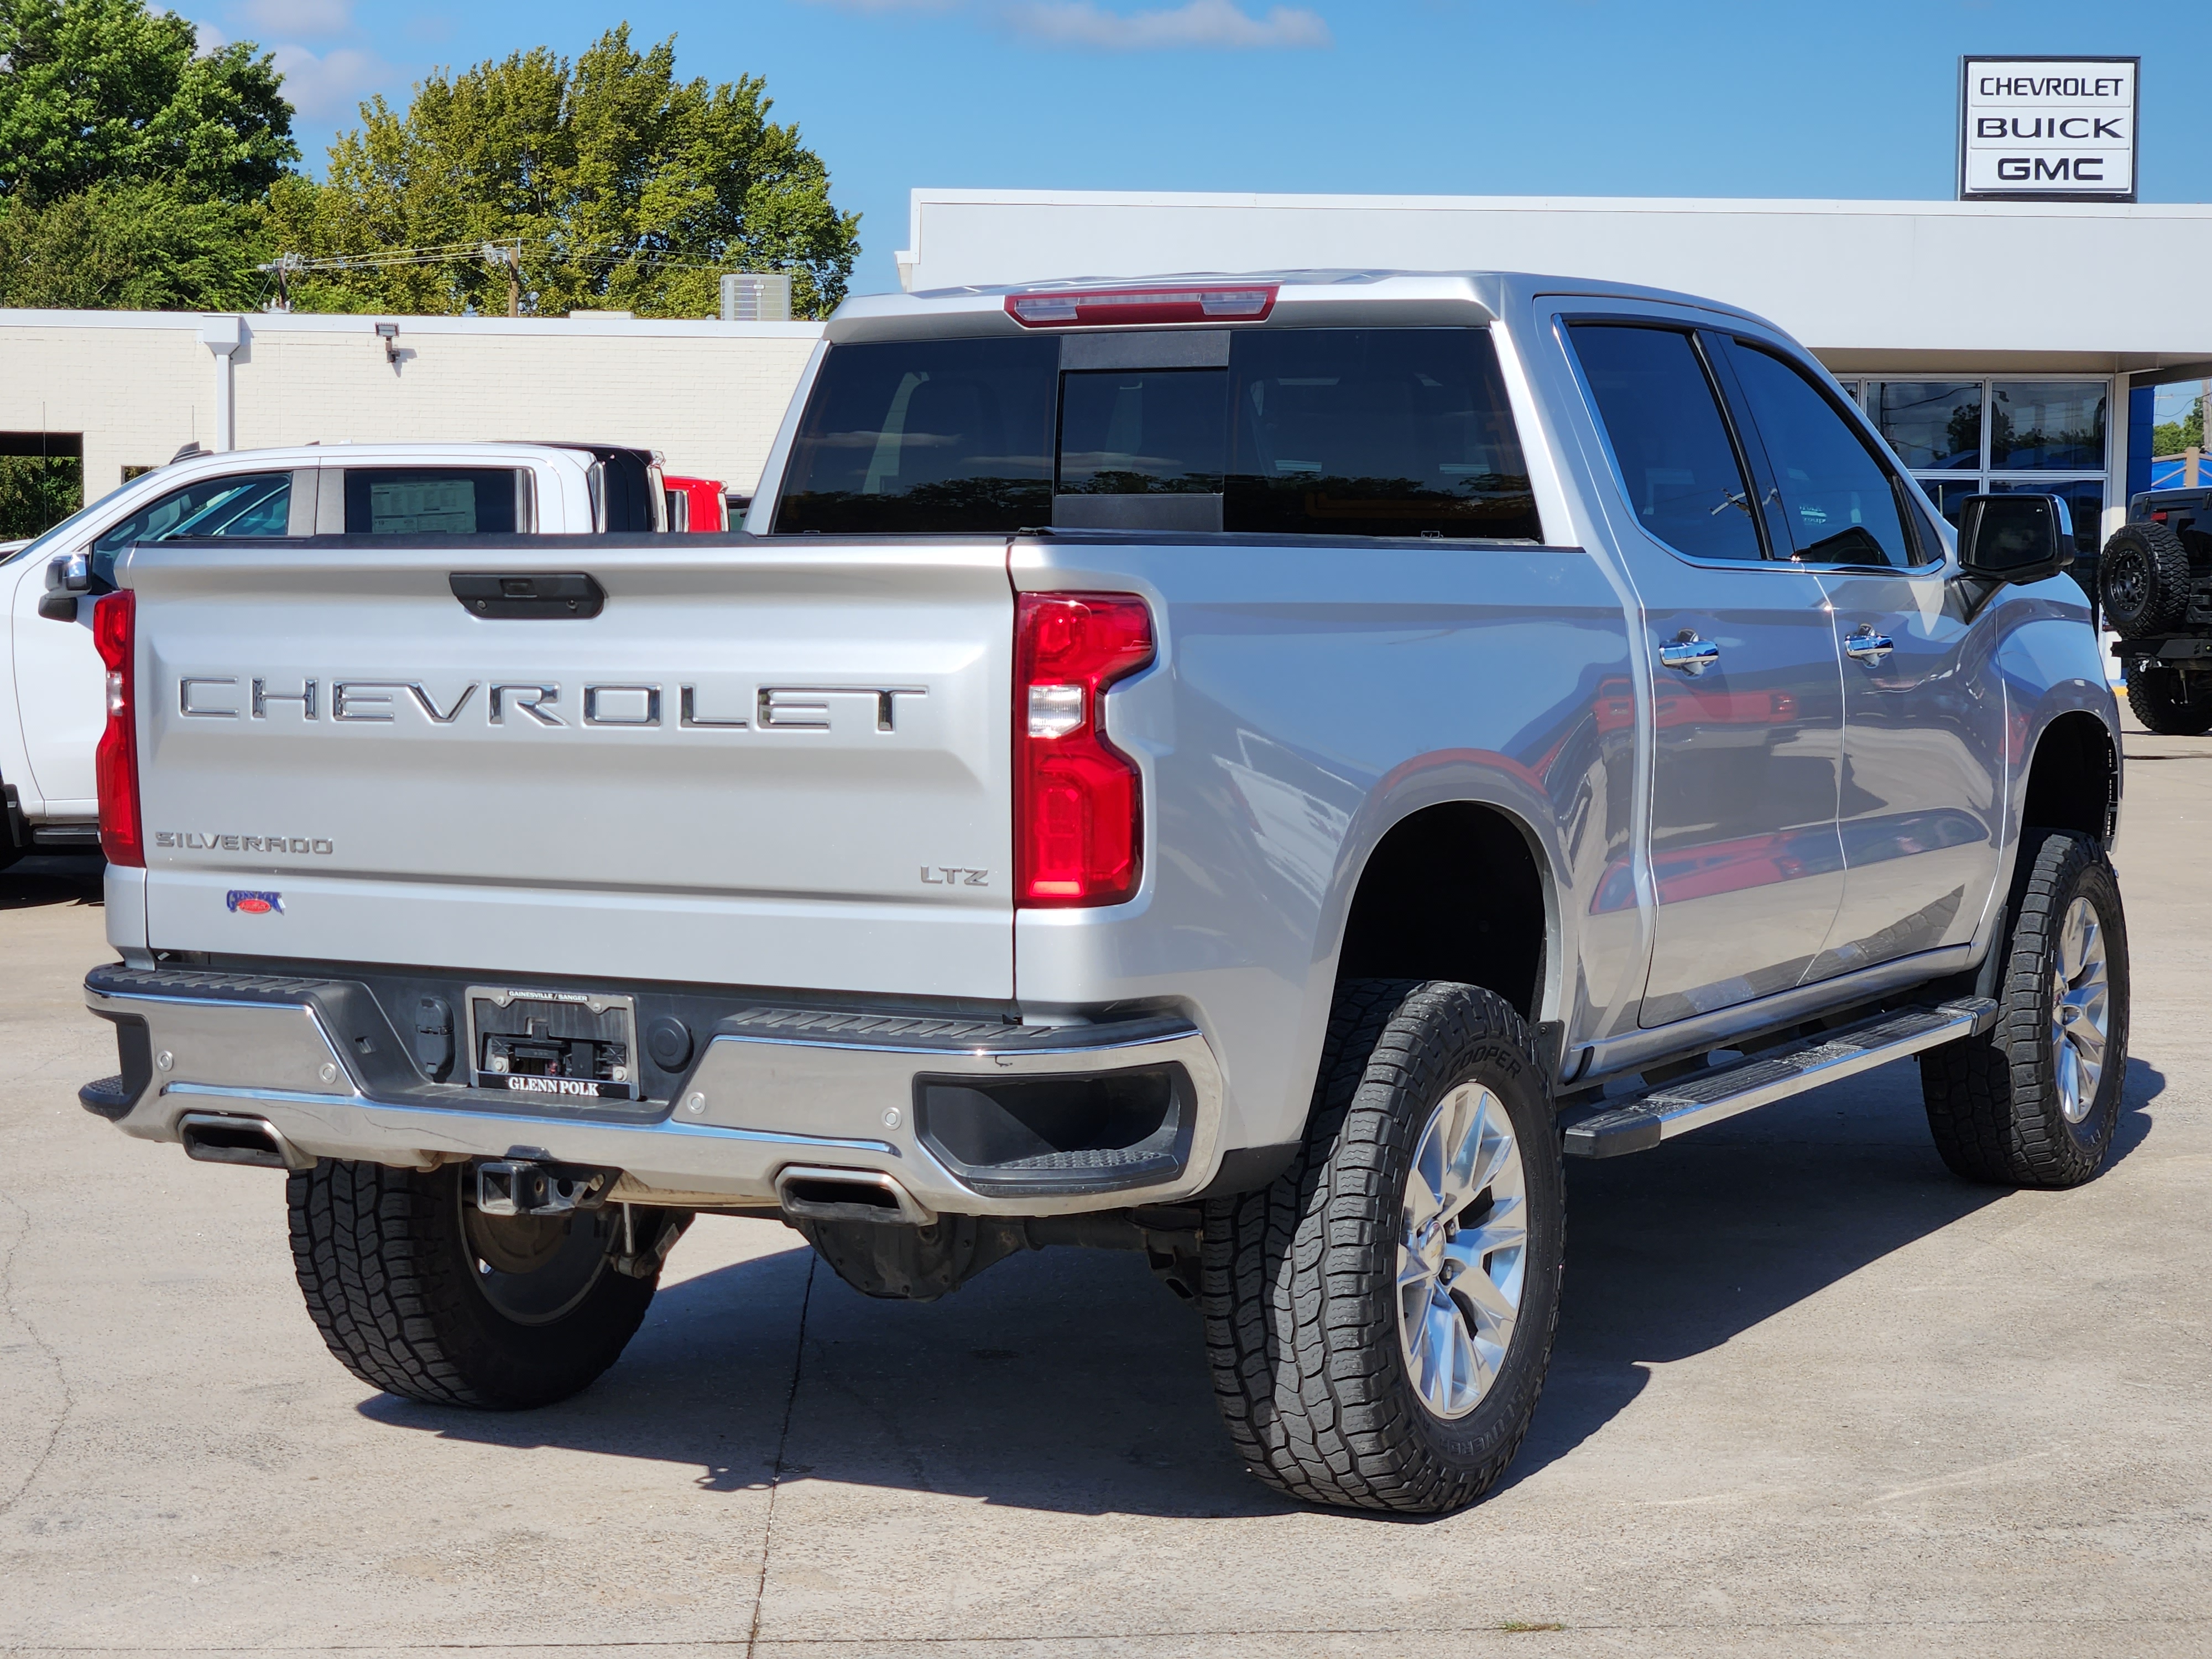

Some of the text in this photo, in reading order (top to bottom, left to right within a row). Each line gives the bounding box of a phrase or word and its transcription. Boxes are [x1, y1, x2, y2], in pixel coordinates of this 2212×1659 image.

[1980, 77, 2124, 96] CHEVROLET
[1977, 117, 2126, 139] BUICK
[1997, 158, 2104, 181] GMC
[179, 676, 930, 732] CHEVROLET
[155, 831, 333, 854] SILVERADO
[920, 865, 989, 886] LTZ
[509, 990, 553, 999] GAINESVILLE
[1448, 1045, 1522, 1081] COOPER
[508, 1077, 600, 1097] GLENN POLK
